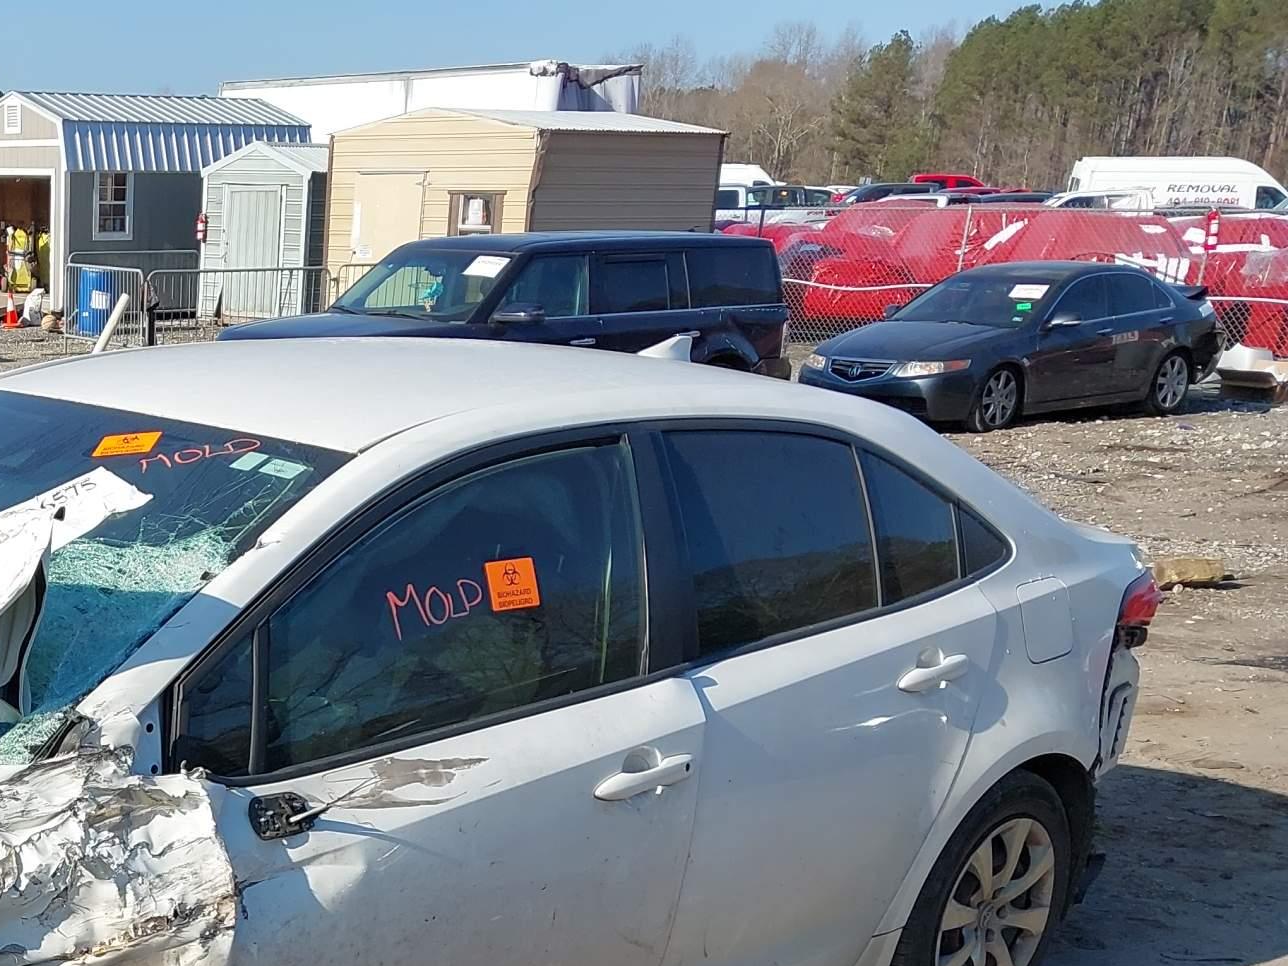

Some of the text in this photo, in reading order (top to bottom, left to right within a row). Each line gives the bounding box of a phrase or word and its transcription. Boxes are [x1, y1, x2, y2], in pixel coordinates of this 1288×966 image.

[1166, 184, 1240, 193] REMOVAL
[139, 438, 261, 474] MOLD
[497, 588, 532, 598] BIOHAZARD
[386, 579, 483, 640] MOLD
